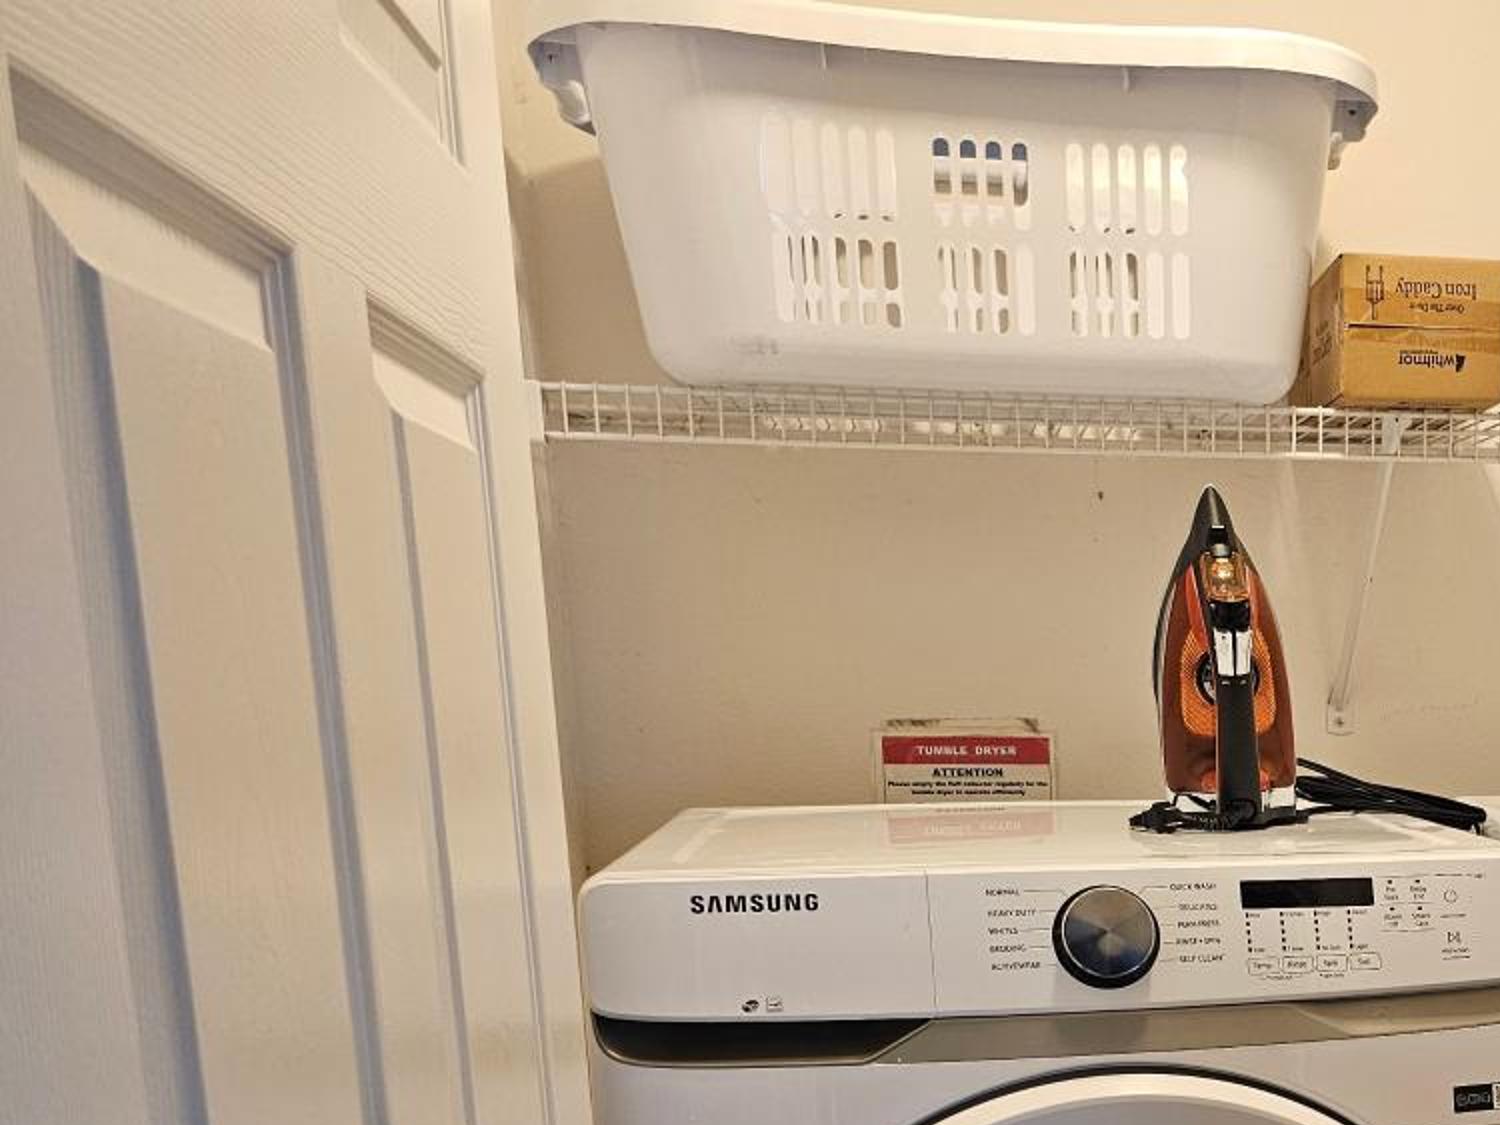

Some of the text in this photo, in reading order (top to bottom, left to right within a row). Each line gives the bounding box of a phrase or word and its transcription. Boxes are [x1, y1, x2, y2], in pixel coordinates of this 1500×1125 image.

[1395, 277, 1477, 300] Iron Caddy
[1398, 352, 1455, 369] whitmor
[916, 744, 1017, 756] TUMBLE DRYER
[932, 767, 1004, 778] ATTENTION
[689, 893, 819, 915] SAMSUNG
